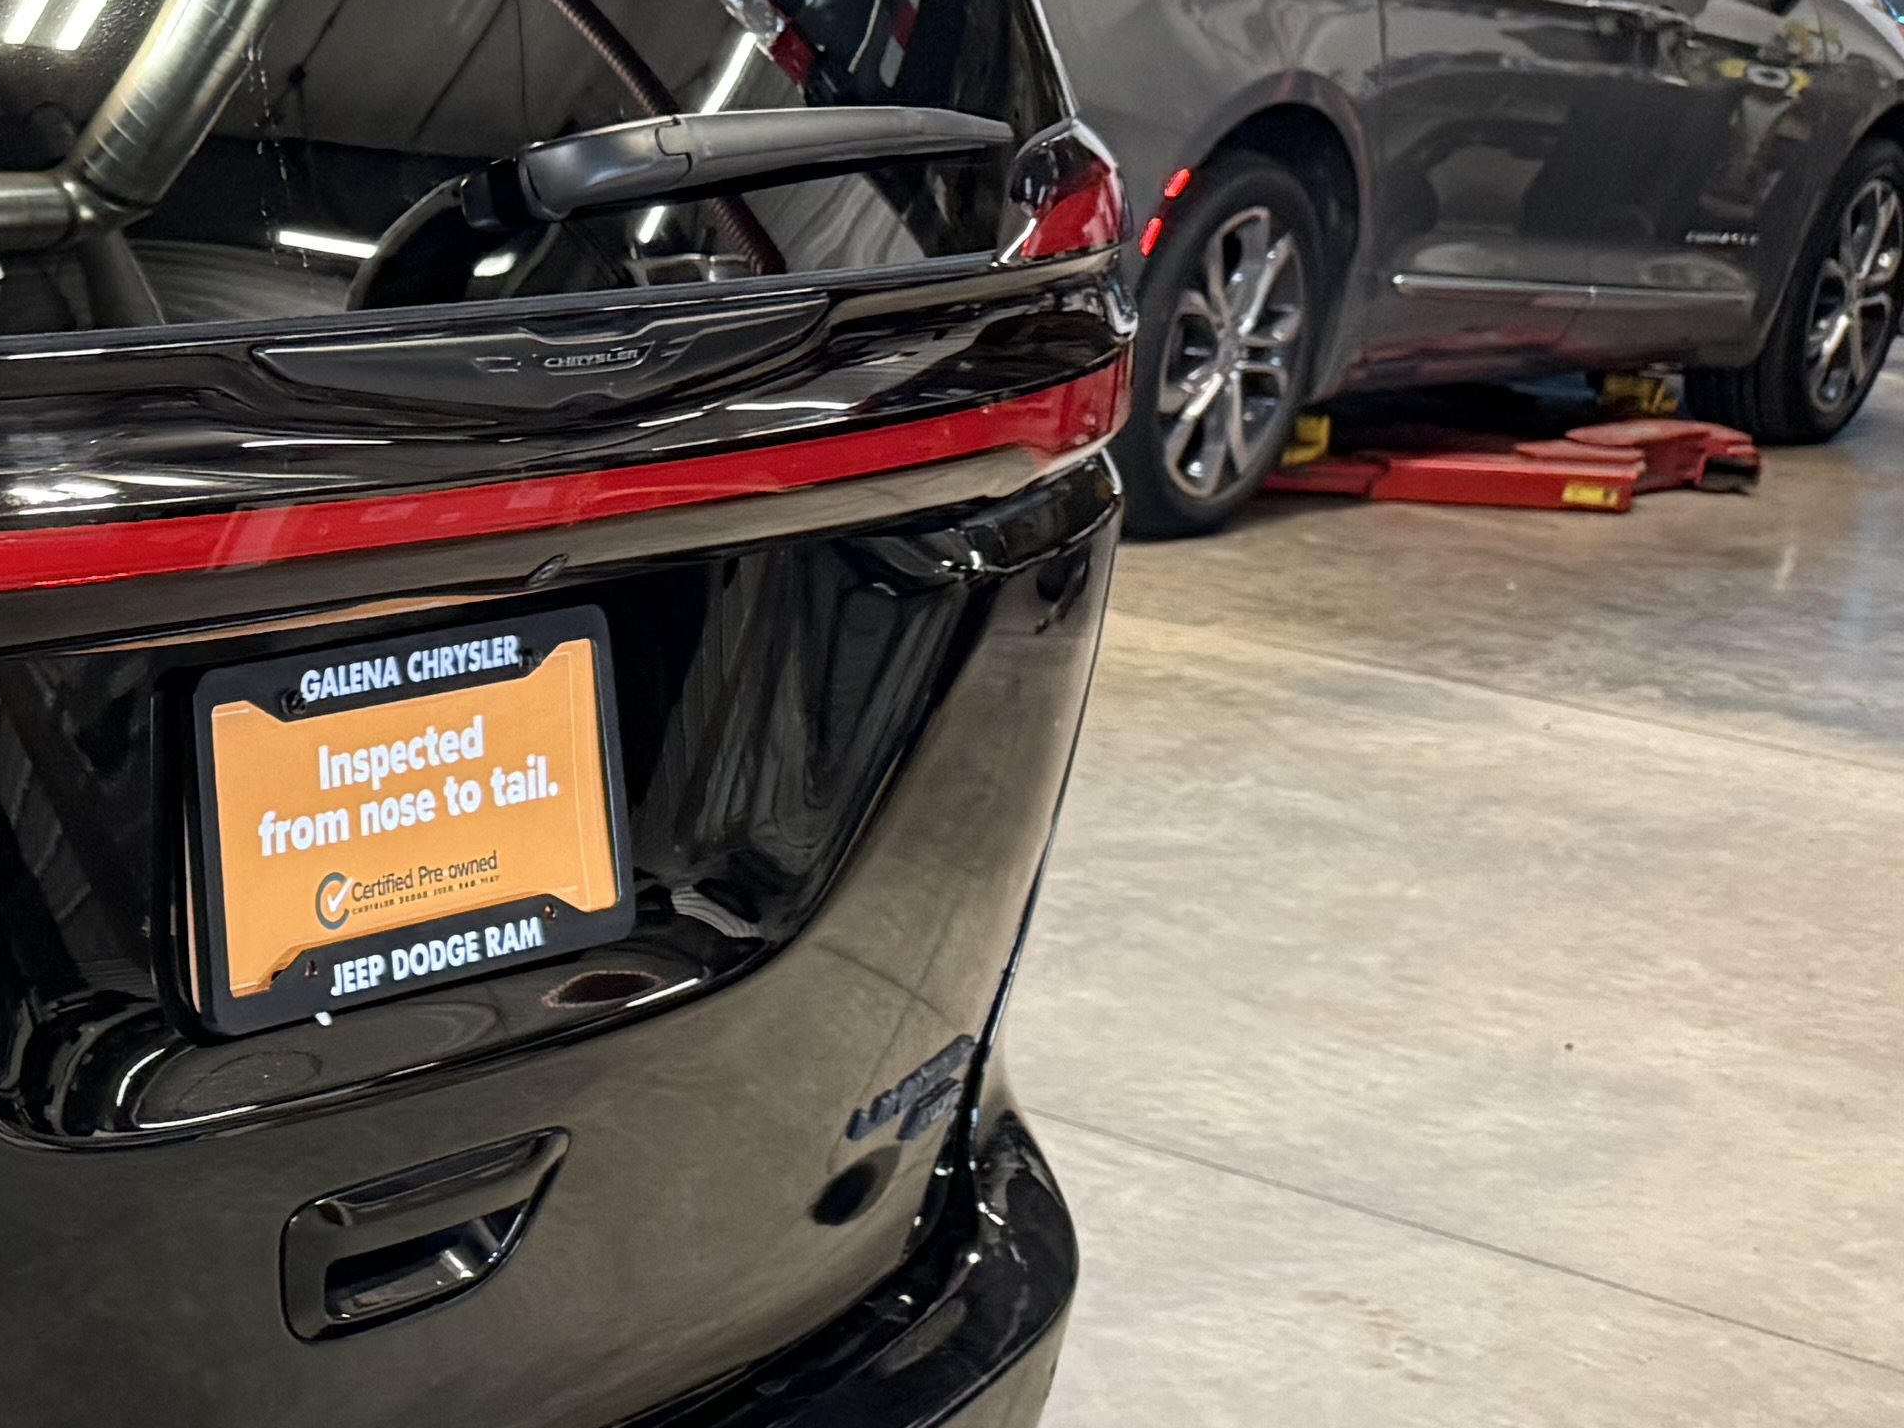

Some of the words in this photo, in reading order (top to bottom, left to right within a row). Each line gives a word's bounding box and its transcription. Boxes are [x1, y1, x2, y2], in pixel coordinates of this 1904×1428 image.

[544, 349, 638, 368] CHRYSLER
[300, 656, 402, 703] GALENA
[407, 635, 519, 683] CHRYSLER
[318, 715, 484, 790] Inspected
[258, 810, 349, 857] from
[360, 788, 436, 836] nose
[443, 776, 482, 816] to
[490, 753, 559, 807] tail.
[351, 869, 413, 902] Certified
[419, 866, 443, 886] Pre
[448, 849, 498, 879] owned
[330, 954, 385, 996] JEEP
[391, 931, 480, 981] DODGE
[484, 916, 544, 958] RAM
